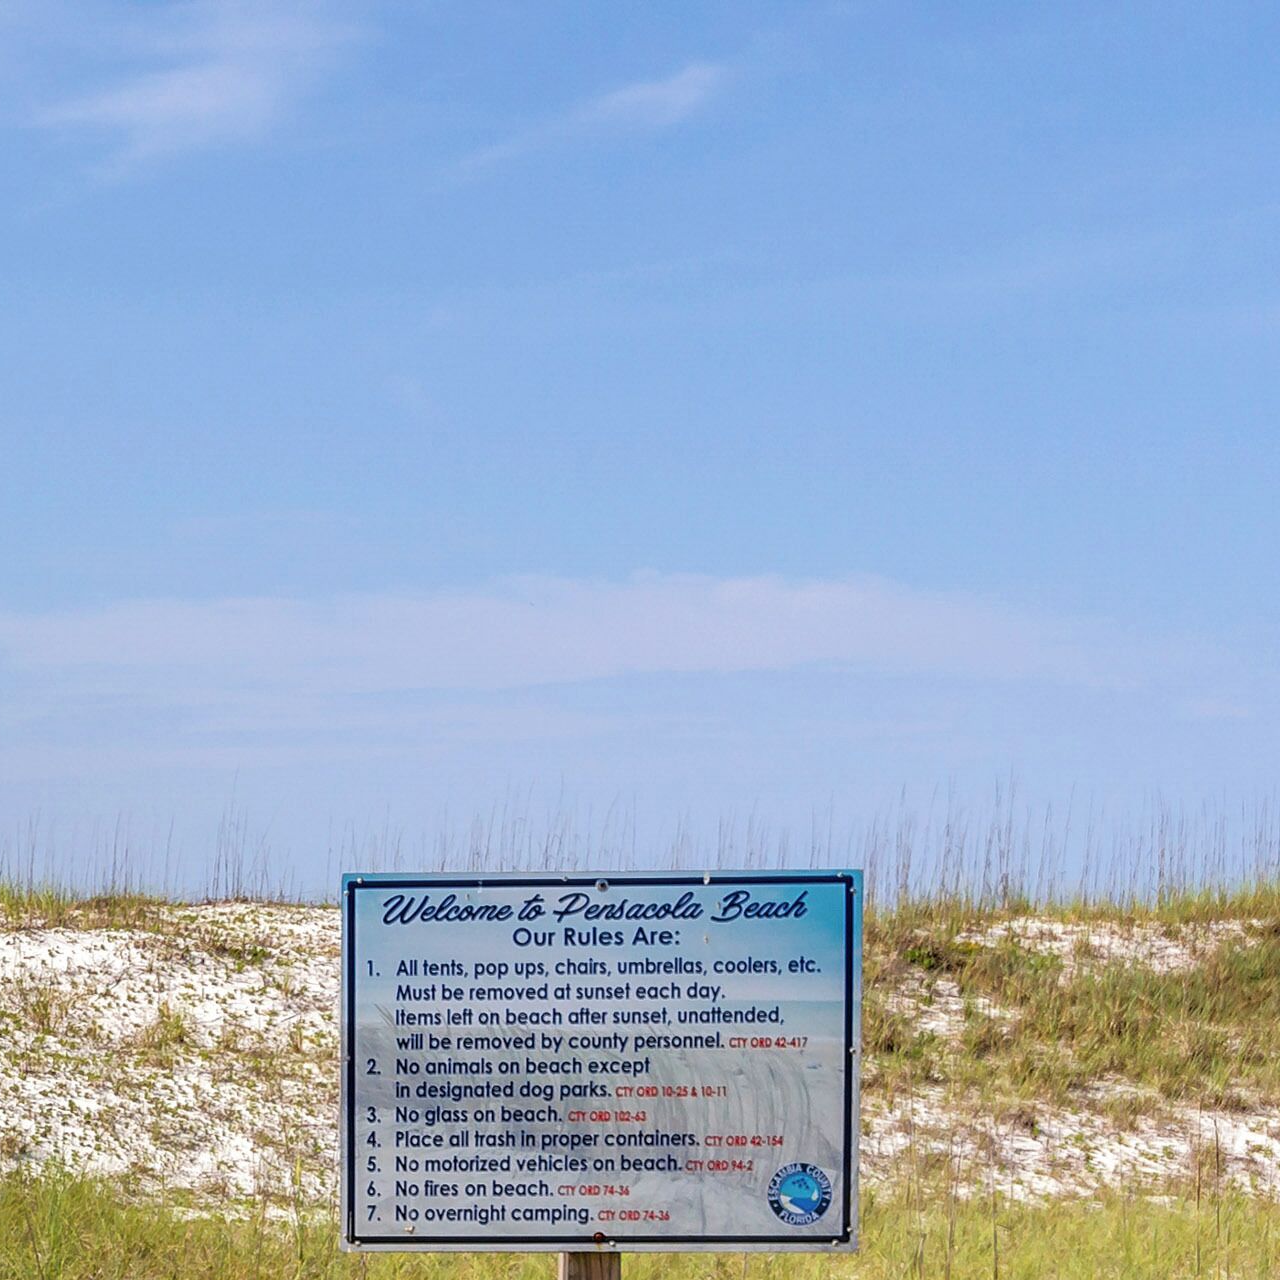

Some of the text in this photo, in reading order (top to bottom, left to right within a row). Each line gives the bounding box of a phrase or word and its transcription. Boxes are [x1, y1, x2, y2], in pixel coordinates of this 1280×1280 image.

[382, 891, 808, 925] Welcome to Pensacola Beach
[513, 927, 680, 946] Our Rules Are:
[368, 956, 820, 980] 1. All tents, pop ups, chairs, umbrellas, coolers, etc.
[397, 982, 725, 1003] Must be removed at sunset each day.
[396, 1006, 784, 1027] Items left on beach after sunset, unattended,
[397, 1032, 808, 1054] will be removed by county personnel. CTY ORD 42-417
[367, 1057, 650, 1078] 2. No animals on beach except
[396, 1082, 410, 1099] in
[416, 1081, 513, 1103] designated
[520, 1081, 553, 1102] dog
[560, 1081, 612, 1102] parks.
[615, 1086, 635, 1099] CTY
[636, 1086, 659, 1098] ORD
[662, 1086, 688, 1098] 10-25
[701, 1086, 727, 1098] 10-11
[367, 1105, 646, 1127] 3. No glass on beach. CTY ORD 102-63
[367, 1129, 784, 1151] 4. Place all trash in proper containers. CTY ORD 42-154
[367, 1154, 753, 1173] 5. No motorized vehicles on beach. CTY ORD 94-2
[367, 1180, 629, 1198] 6. No fires on beach. CTY ORD 74-36
[806, 1165, 831, 1200] COUNTY
[367, 1204, 670, 1226] 7. No overnight camping. CTY ORD 74-36
[779, 1211, 819, 1225] FLORIDA
